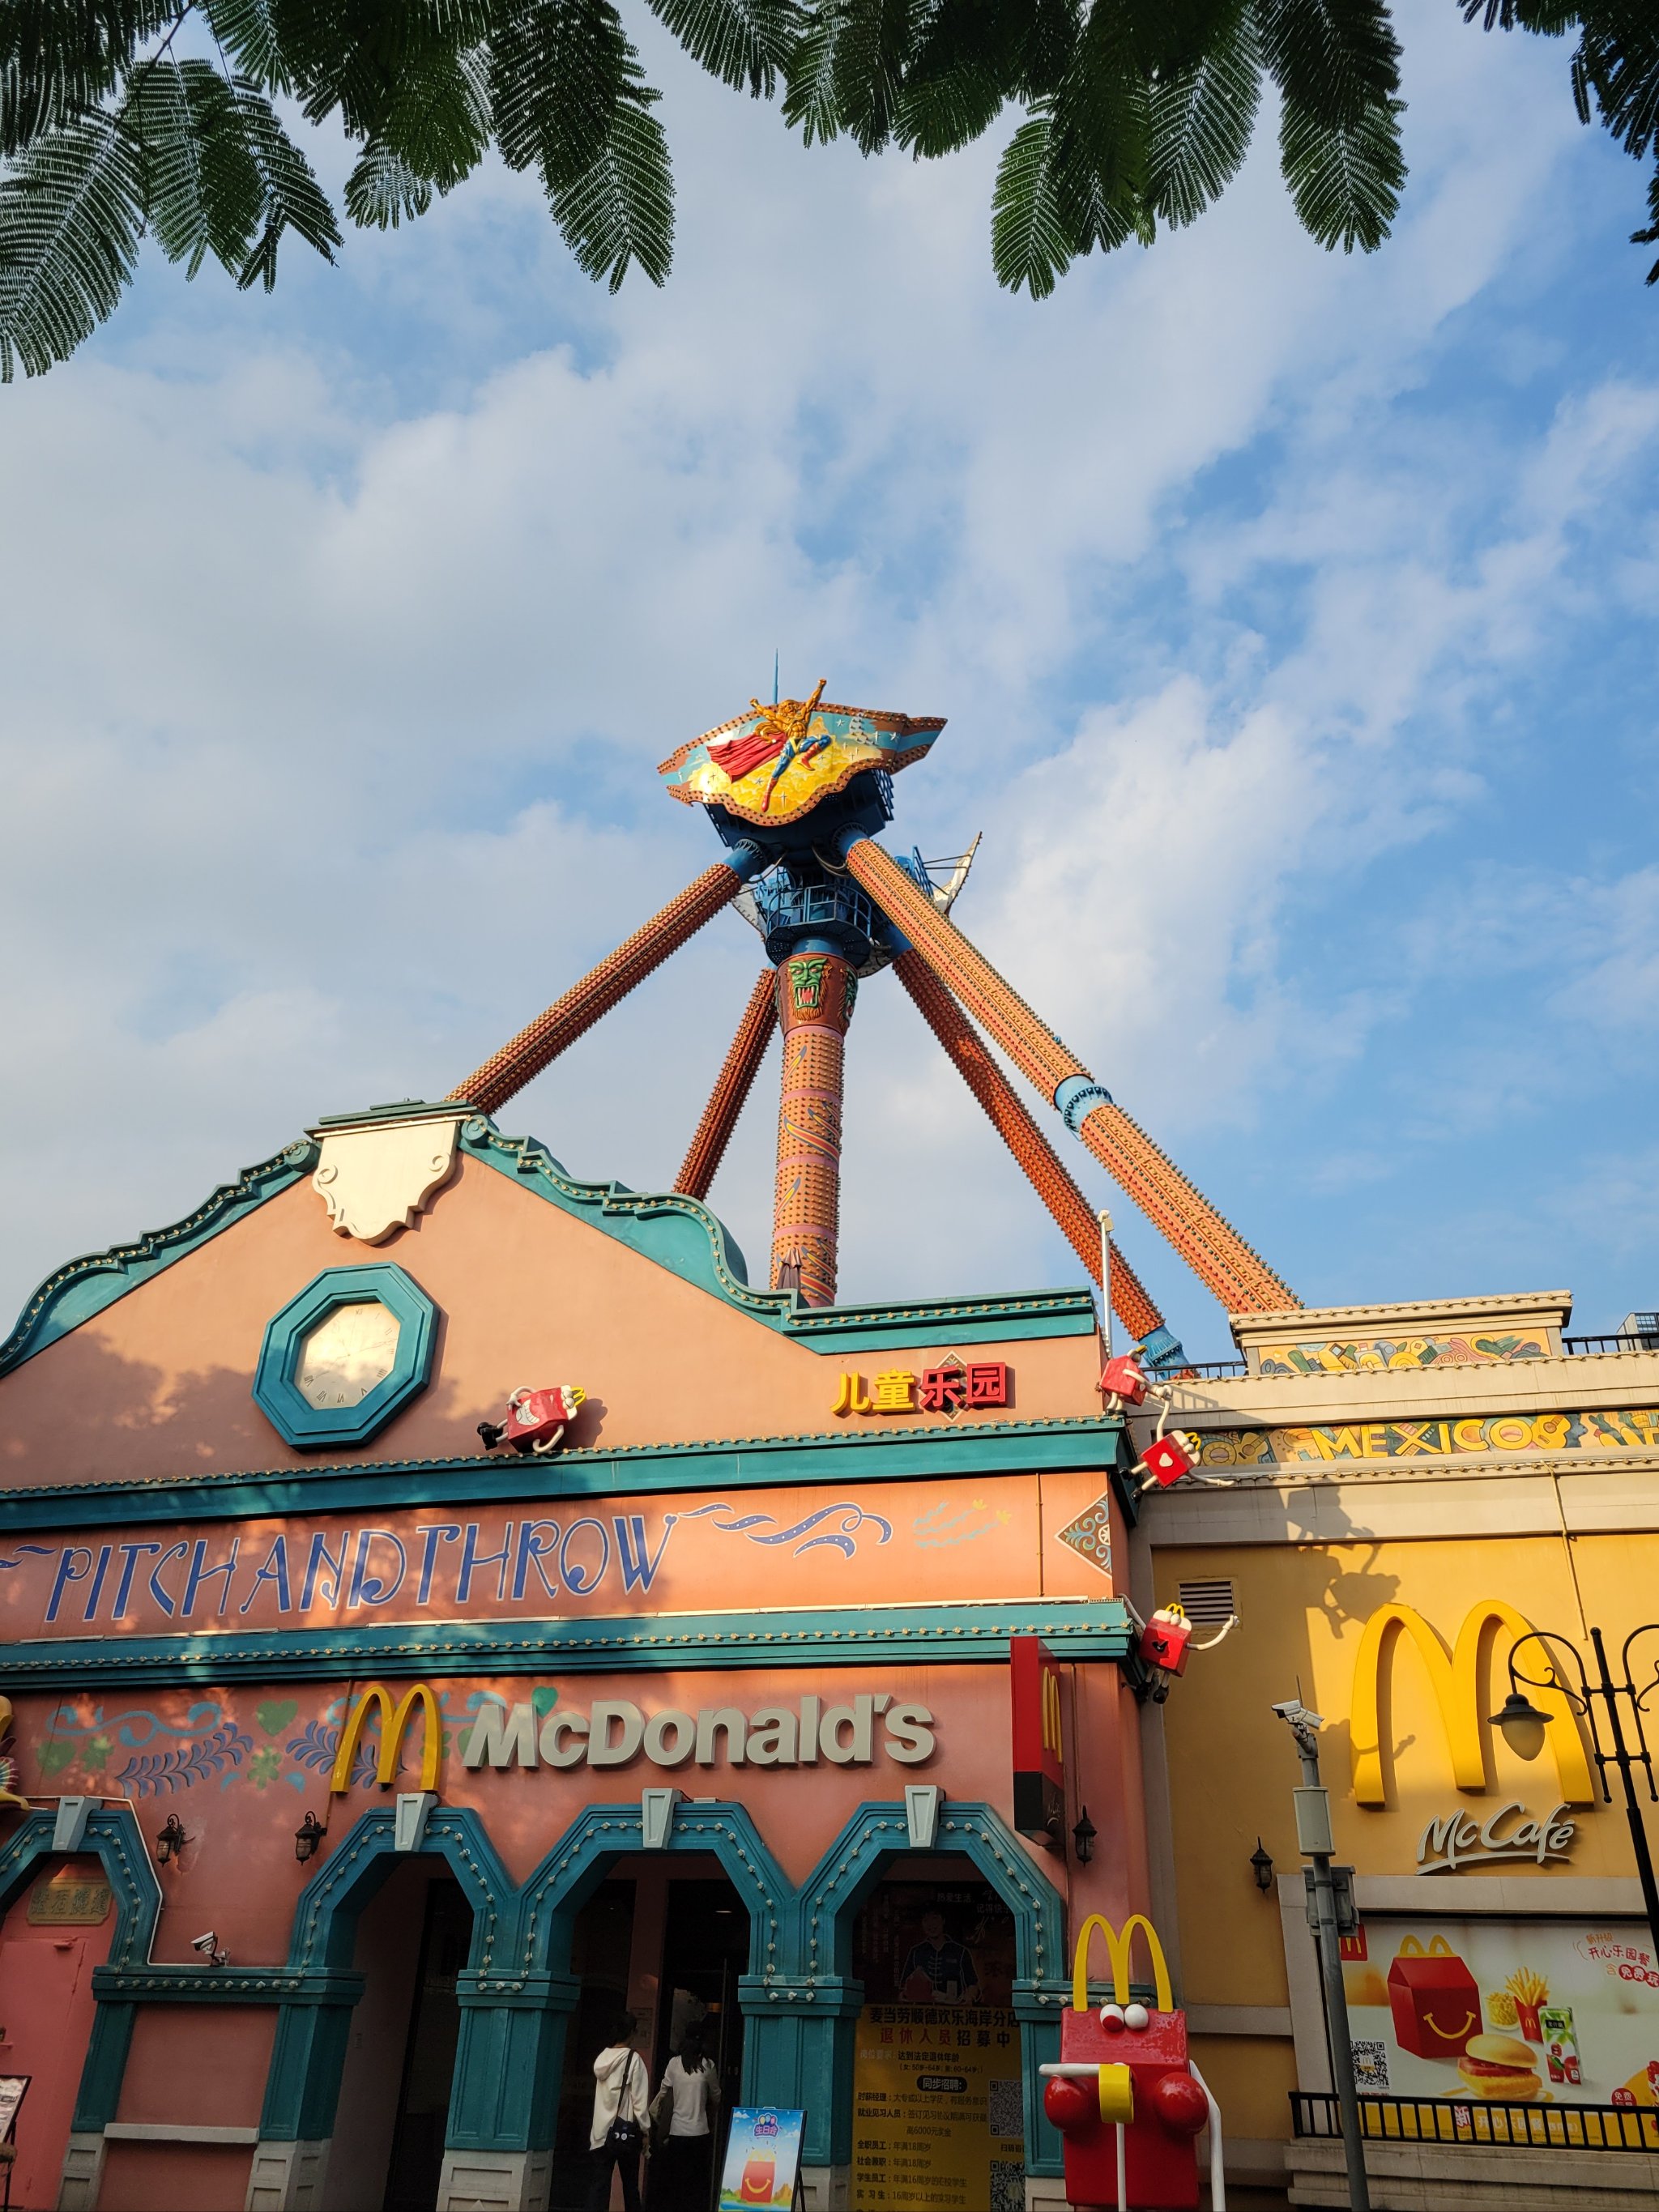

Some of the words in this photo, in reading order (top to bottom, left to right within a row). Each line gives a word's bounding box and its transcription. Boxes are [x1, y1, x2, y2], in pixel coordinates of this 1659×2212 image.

[830, 1361, 1009, 1415] 儿童乐园
[1311, 1417, 1533, 1460] MEXICO
[461, 1692, 936, 1768] McDonald's
[1416, 1802, 1576, 1870] McCafé
[1588, 1944, 1651, 1967] 开心乐园餐
[870, 2007, 1020, 2028] 麦当劳顺德欢乐海岸分店
[755, 2124, 778, 2136] 生日会
[1000, 2143, 1024, 2153] 扫码咨
